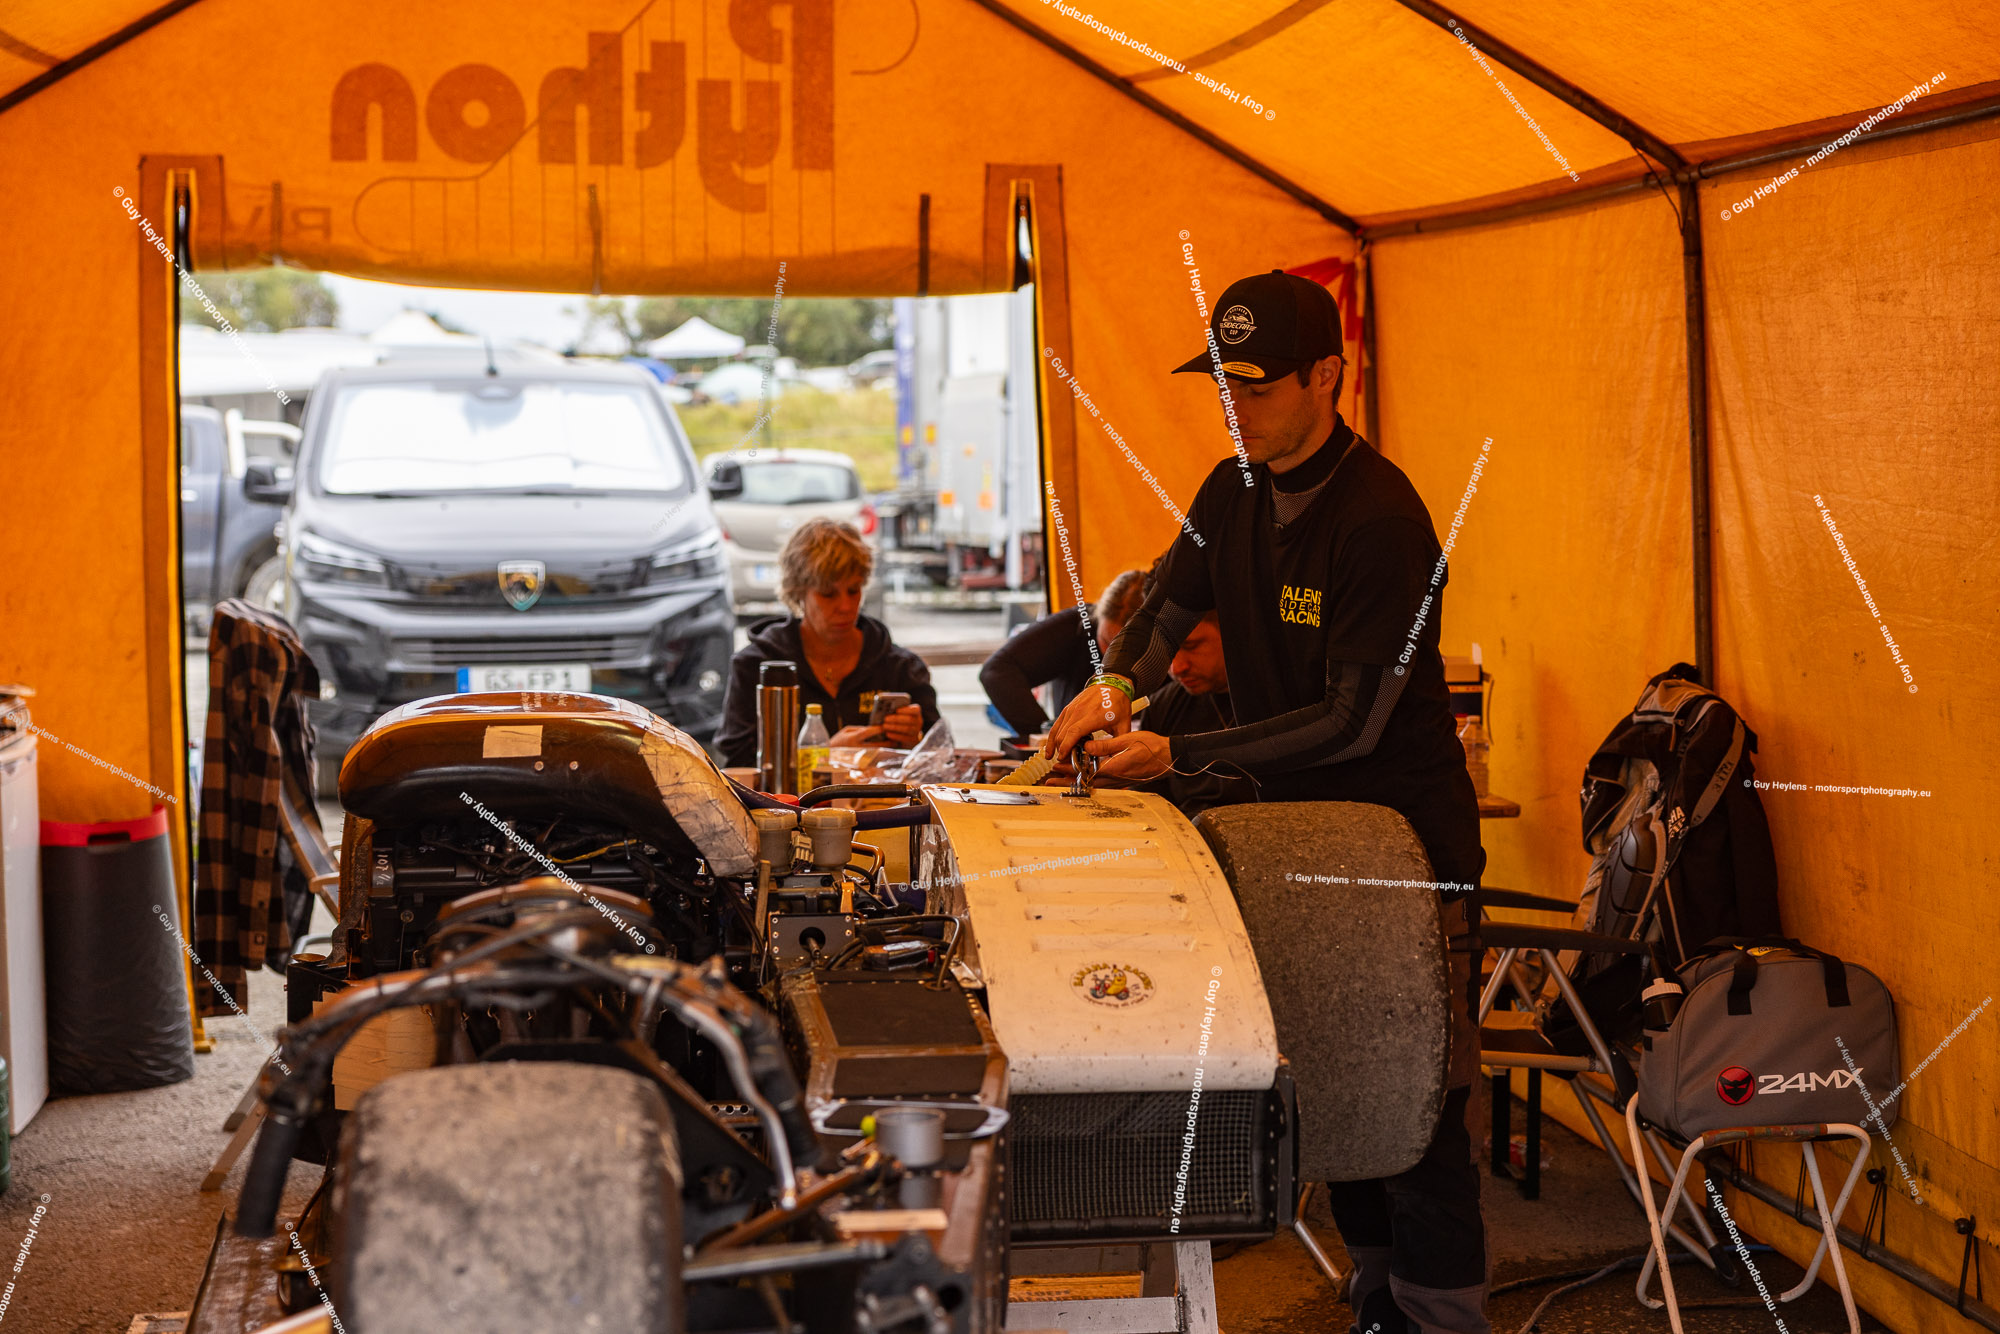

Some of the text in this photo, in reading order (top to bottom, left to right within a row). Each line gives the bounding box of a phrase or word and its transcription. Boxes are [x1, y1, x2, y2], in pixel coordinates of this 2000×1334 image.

[1223, 322, 1251, 331] SIDECAR
[1280, 608, 1320, 628] RACING
[1758, 1067, 1864, 1095] 24MX
